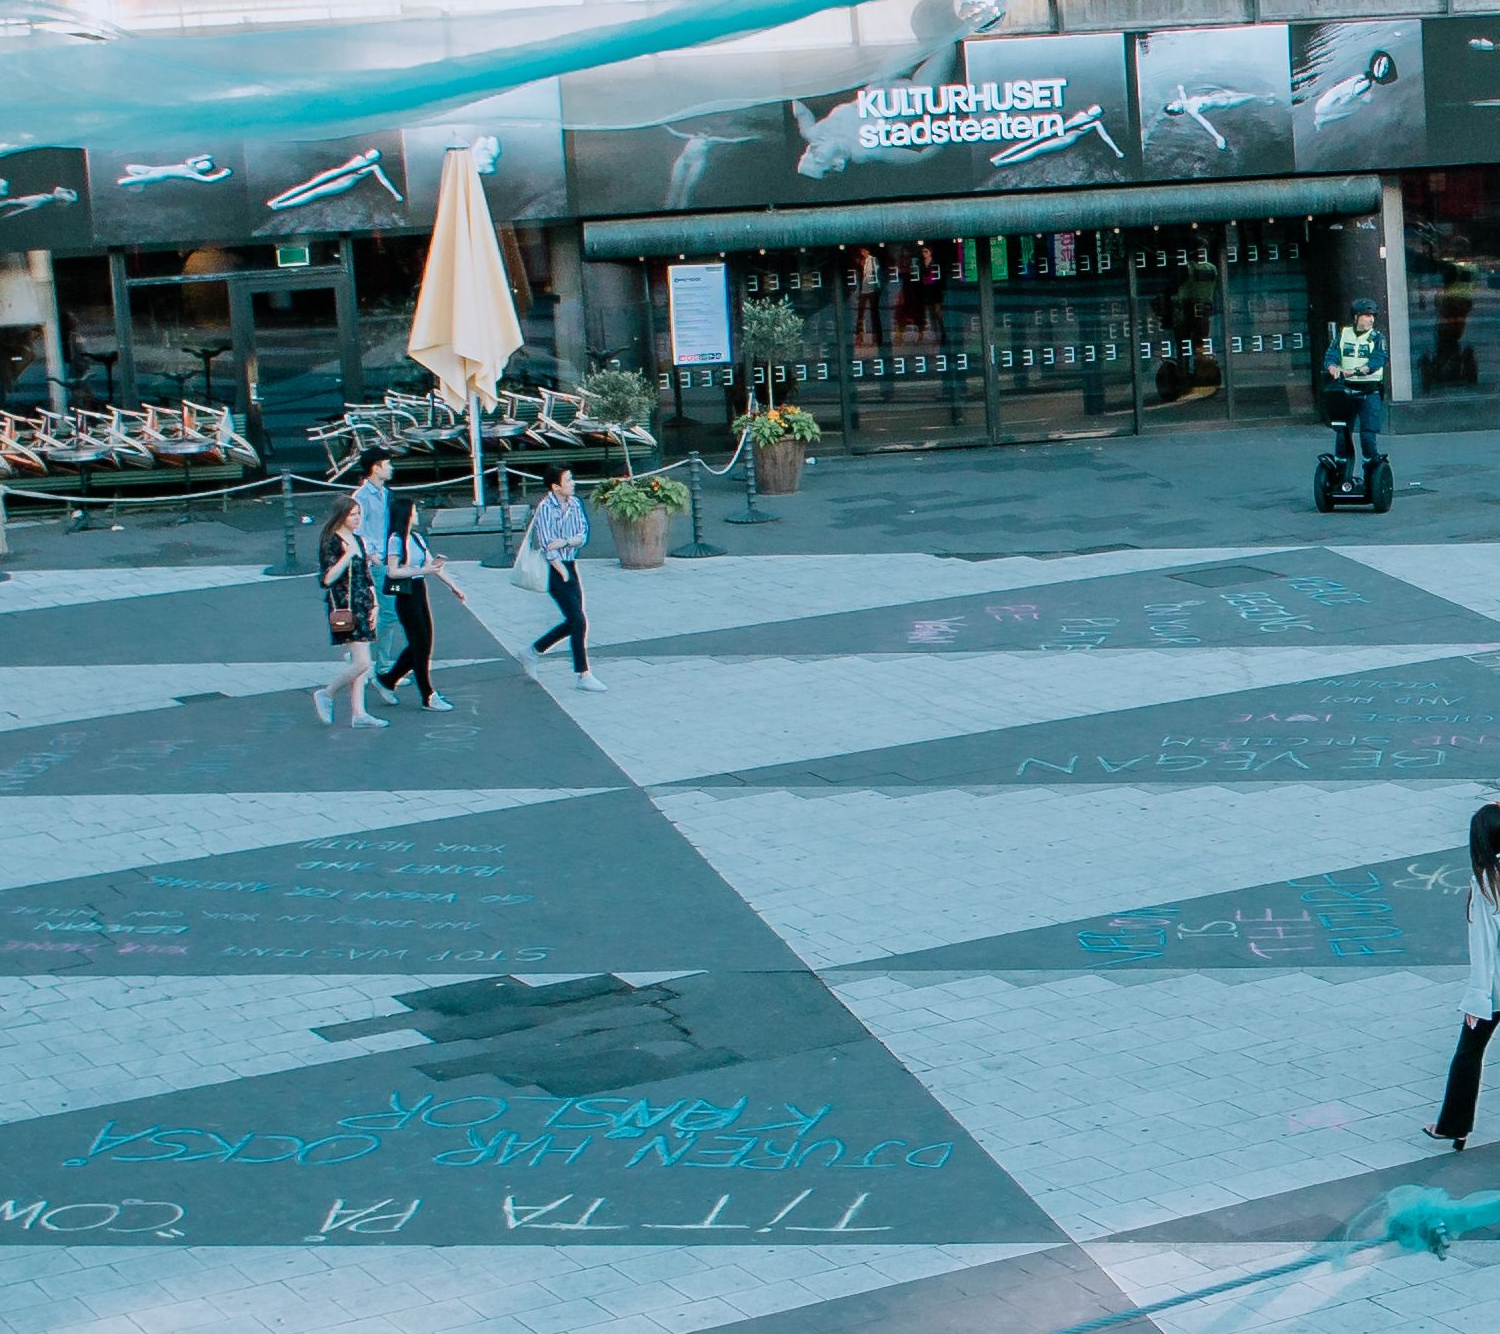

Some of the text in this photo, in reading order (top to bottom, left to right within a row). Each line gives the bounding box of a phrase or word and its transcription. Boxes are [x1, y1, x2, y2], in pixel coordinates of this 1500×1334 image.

[858, 78, 1068, 120] KULTURHUSET
[859, 110, 1067, 148] stadsteatern
[1015, 748, 1445, 776] BE VEGAN
